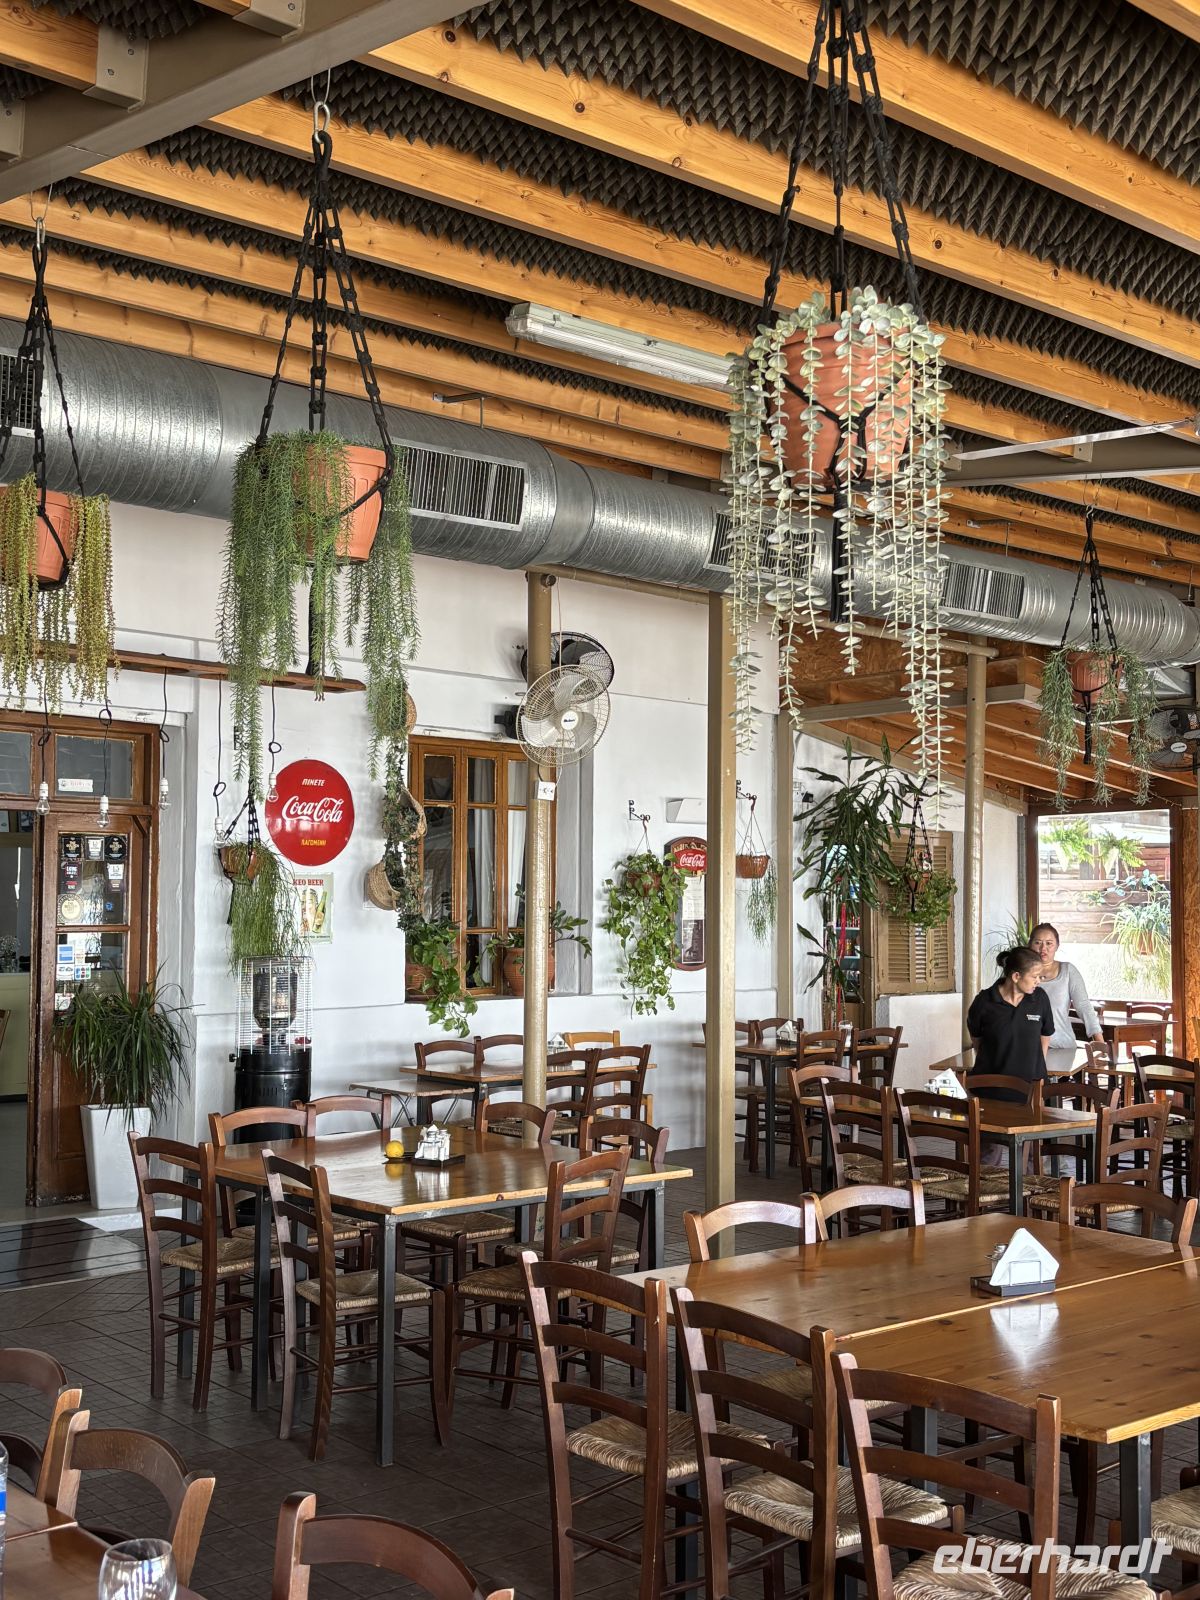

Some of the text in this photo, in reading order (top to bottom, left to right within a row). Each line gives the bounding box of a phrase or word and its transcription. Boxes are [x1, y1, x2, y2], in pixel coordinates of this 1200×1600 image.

[302, 779, 325, 787] ΠΙΝΕΤΕ
[282, 795, 344, 824] Coca-Cola
[680, 854, 705, 867] Coca-Cola
